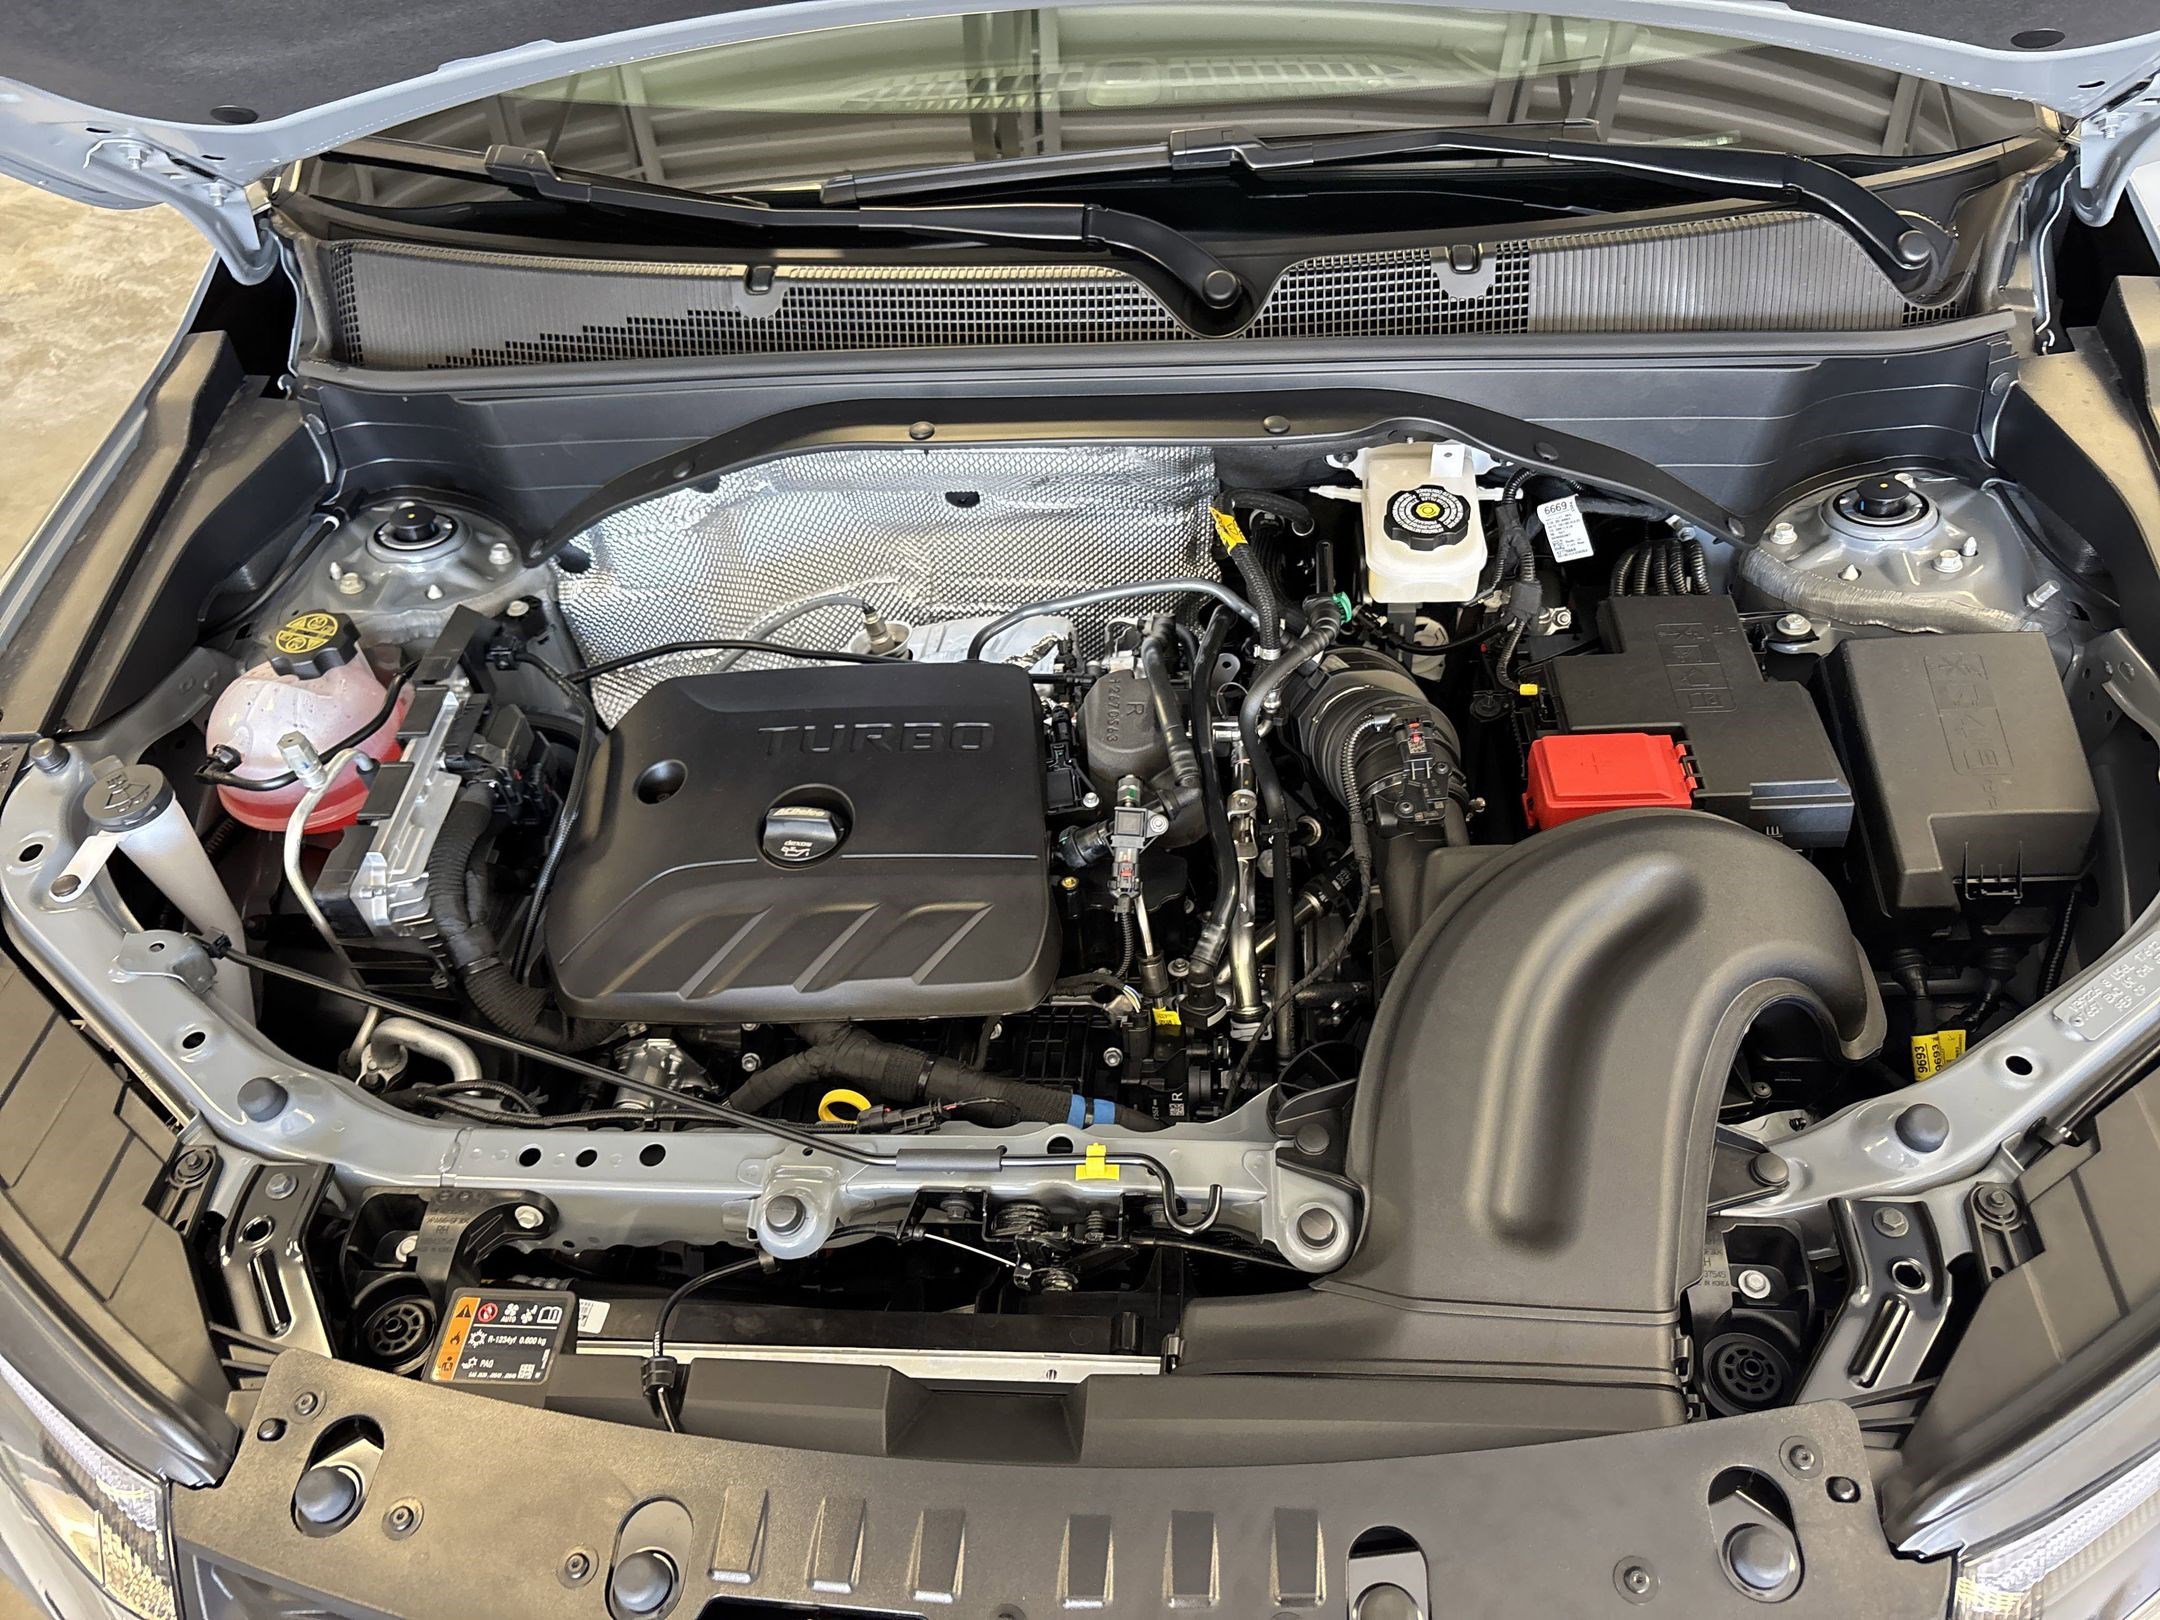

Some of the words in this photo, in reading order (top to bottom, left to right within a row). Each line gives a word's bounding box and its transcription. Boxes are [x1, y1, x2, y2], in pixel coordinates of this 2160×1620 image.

[1544, 501, 1567, 515] 6669
[1126, 702, 1144, 716] R
[757, 722, 995, 755] TURBO
[773, 807, 826, 817] ACDelco
[783, 839, 813, 847] dexos
[1914, 1046, 1928, 1073] 9693
[1931, 1043, 1943, 1072] 9693
[436, 1225, 450, 1235] RH
[488, 1335, 517, 1346] R-1234yf
[537, 1337, 547, 1347] kg
